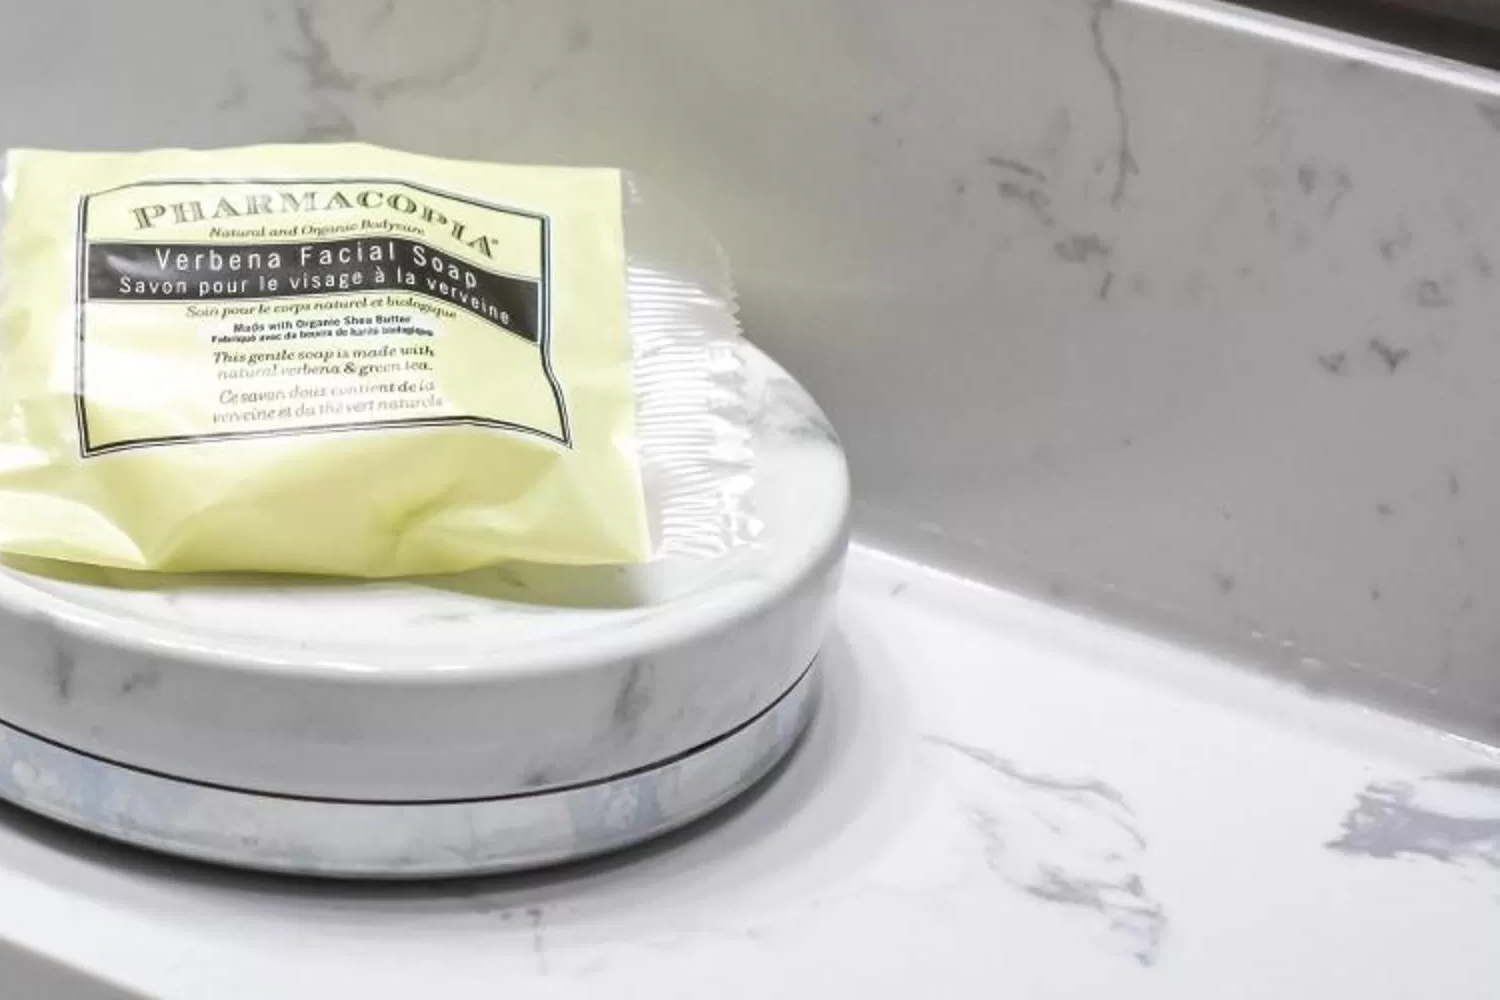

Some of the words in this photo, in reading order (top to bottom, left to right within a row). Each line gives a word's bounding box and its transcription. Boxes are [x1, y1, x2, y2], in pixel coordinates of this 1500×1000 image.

[208, 227, 265, 240] Natural
[269, 225, 298, 238] and
[300, 222, 358, 237] Organic
[156, 247, 282, 271] Verbena
[300, 240, 395, 268] Facial
[412, 244, 478, 290] Soap
[118, 275, 187, 294] Savon
[199, 278, 248, 297] pour
[259, 275, 278, 292] le
[288, 271, 363, 290] visage
[374, 265, 386, 284] à
[396, 265, 416, 286] la
[426, 276, 511, 326] verveine
[186, 304, 220, 318] Soin
[221, 305, 256, 321] pour
[257, 303, 271, 315] le
[273, 302, 311, 315] corps
[313, 298, 367, 311] naturel
[369, 298, 384, 309] et
[233, 322, 265, 333] Made
[268, 319, 293, 331] with
[295, 318, 341, 330] Organic
[343, 314, 373, 326] Shea
[375, 314, 411, 325] Butter
[213, 350, 247, 365] This
[248, 348, 296, 366] gentle
[298, 349, 335, 363] soap
[336, 348, 351, 359] is
[353, 345, 398, 359] made
[399, 344, 435, 357] with
[218, 363, 277, 381] natural
[280, 362, 340, 377] verbena
[343, 361, 357, 374] &
[358, 363, 400, 377] green
[219, 389, 239, 405] Ce
[240, 390, 287, 405] savon
[397, 380, 418, 393] de
[419, 380, 436, 393] la
[278, 405, 293, 418] et
